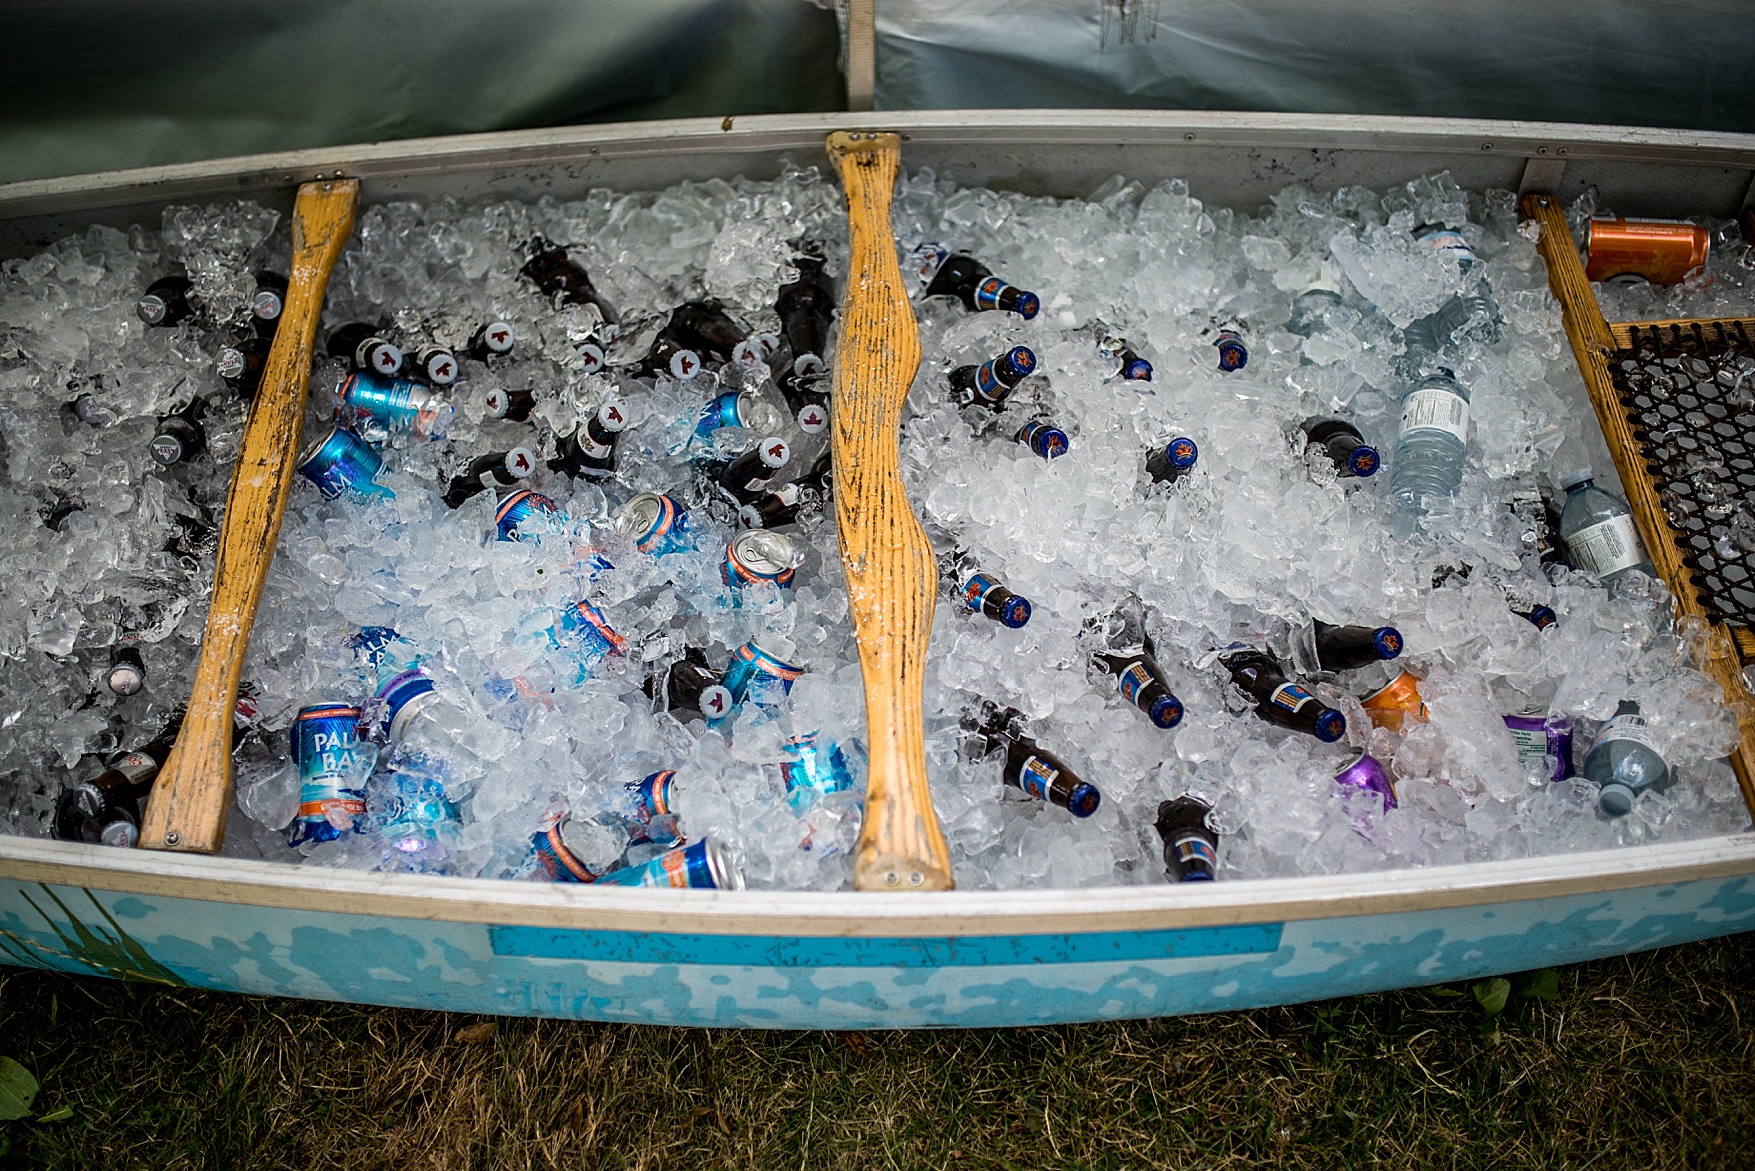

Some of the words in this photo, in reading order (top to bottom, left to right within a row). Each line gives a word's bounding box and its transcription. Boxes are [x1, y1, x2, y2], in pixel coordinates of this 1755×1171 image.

[366, 634, 397, 652] LM
[314, 730, 361, 752] PAL
[321, 750, 357, 771] BA
